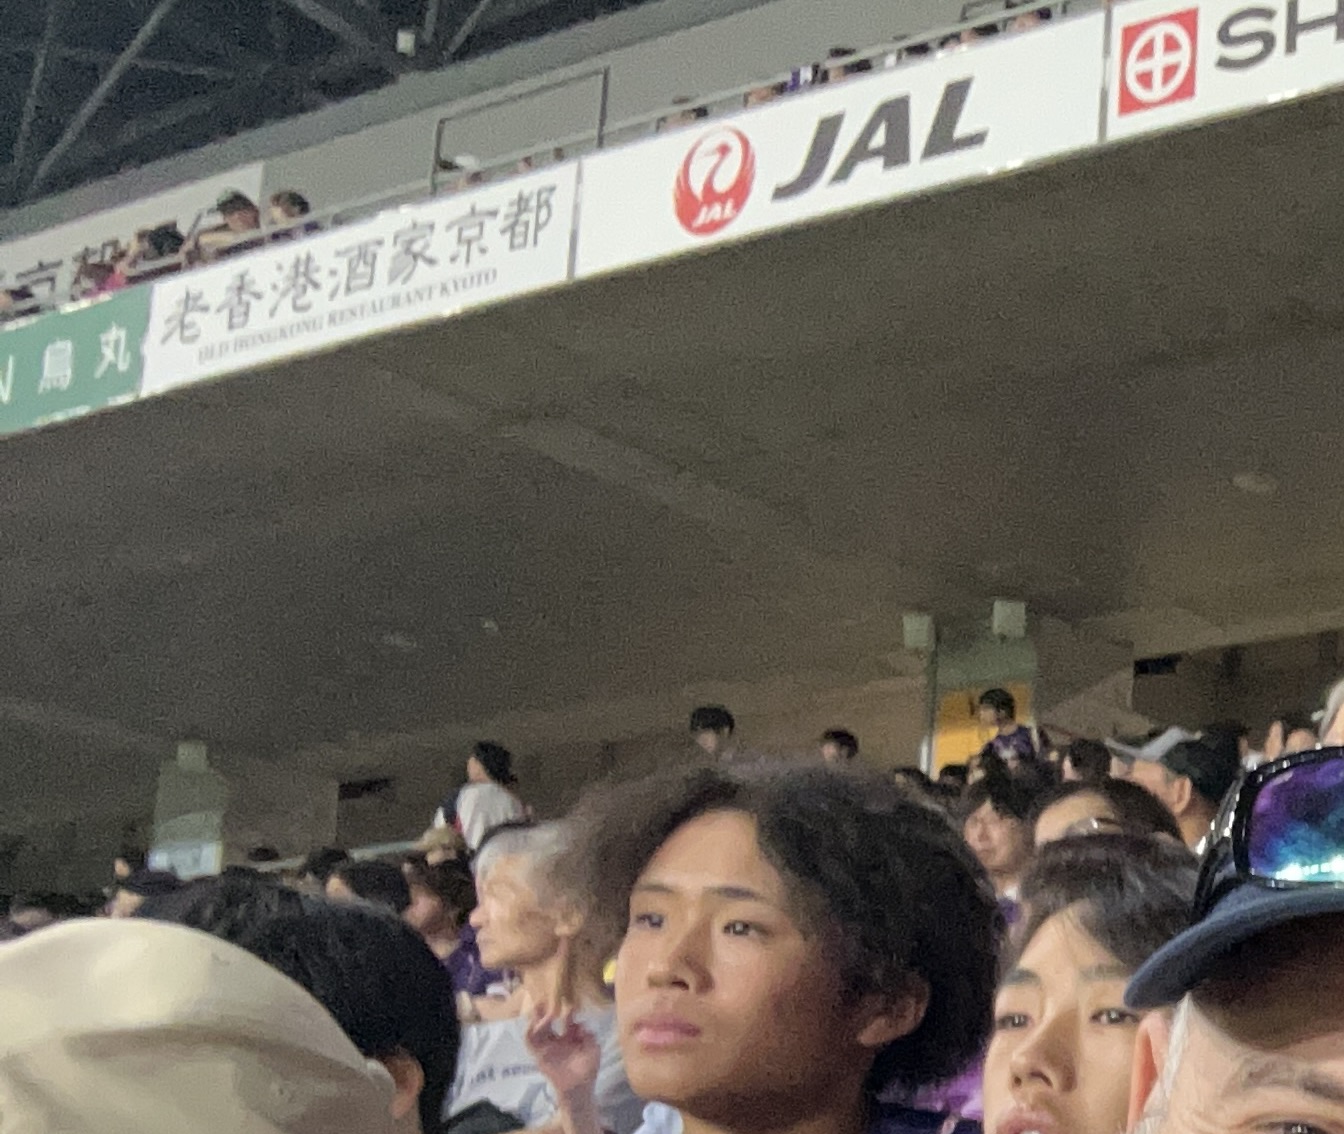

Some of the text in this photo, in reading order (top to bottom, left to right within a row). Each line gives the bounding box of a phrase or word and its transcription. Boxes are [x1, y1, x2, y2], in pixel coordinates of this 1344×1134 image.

[770, 75, 989, 204] JAL
[691, 199, 737, 229] JAL
[160, 182, 557, 346] 老香港酒家京都
[437, 267, 498, 298] KYOTO
